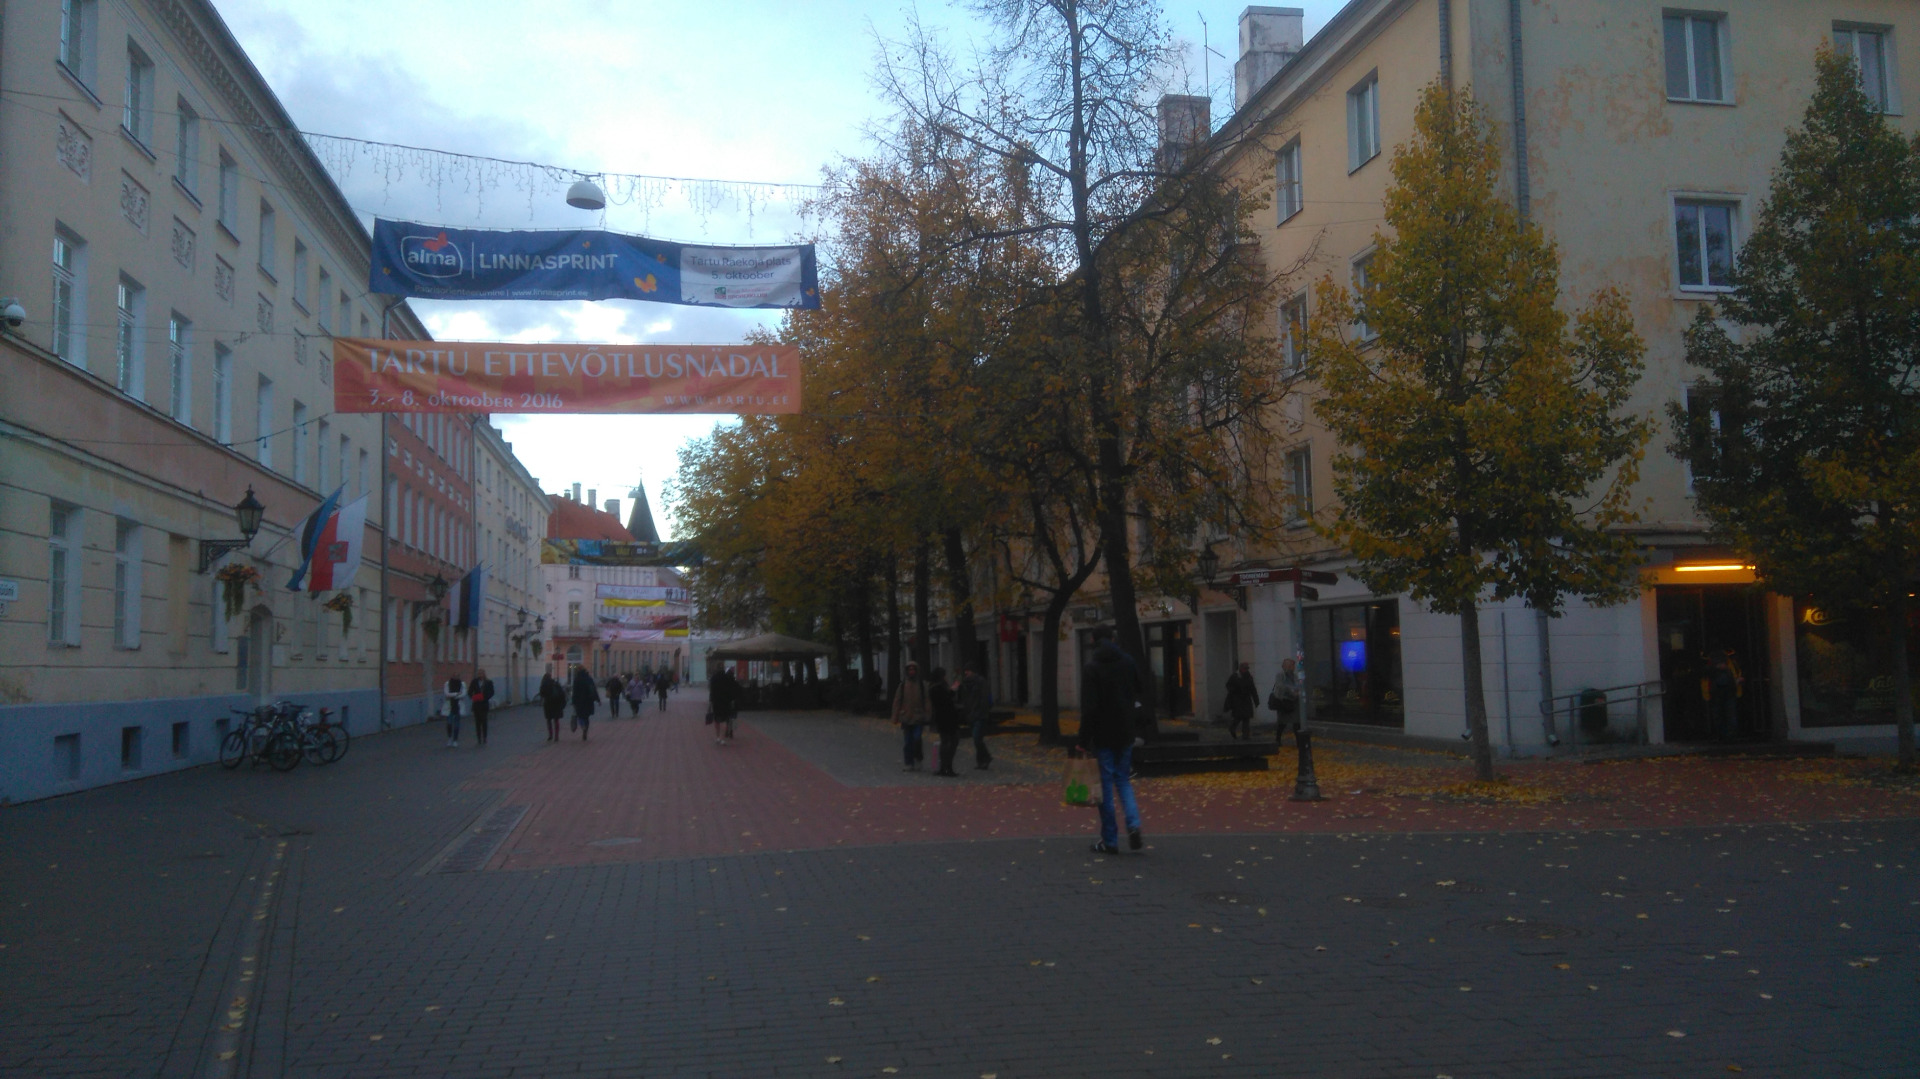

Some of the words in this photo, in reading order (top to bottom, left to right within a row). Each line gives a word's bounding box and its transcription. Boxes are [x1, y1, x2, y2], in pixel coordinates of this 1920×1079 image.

[407, 249, 457, 267] alma
[480, 253, 618, 271] LINNASPRINT
[691, 256, 720, 267] Tartu
[722, 257, 764, 269] Raekoja
[766, 256, 792, 268] plats
[711, 271, 721, 280] 5.
[725, 271, 774, 280] oktoober
[366, 349, 468, 375] TARTU
[486, 347, 788, 378] ETTEVÕTLUSNÄDAL
[520, 391, 563, 409] 2016
